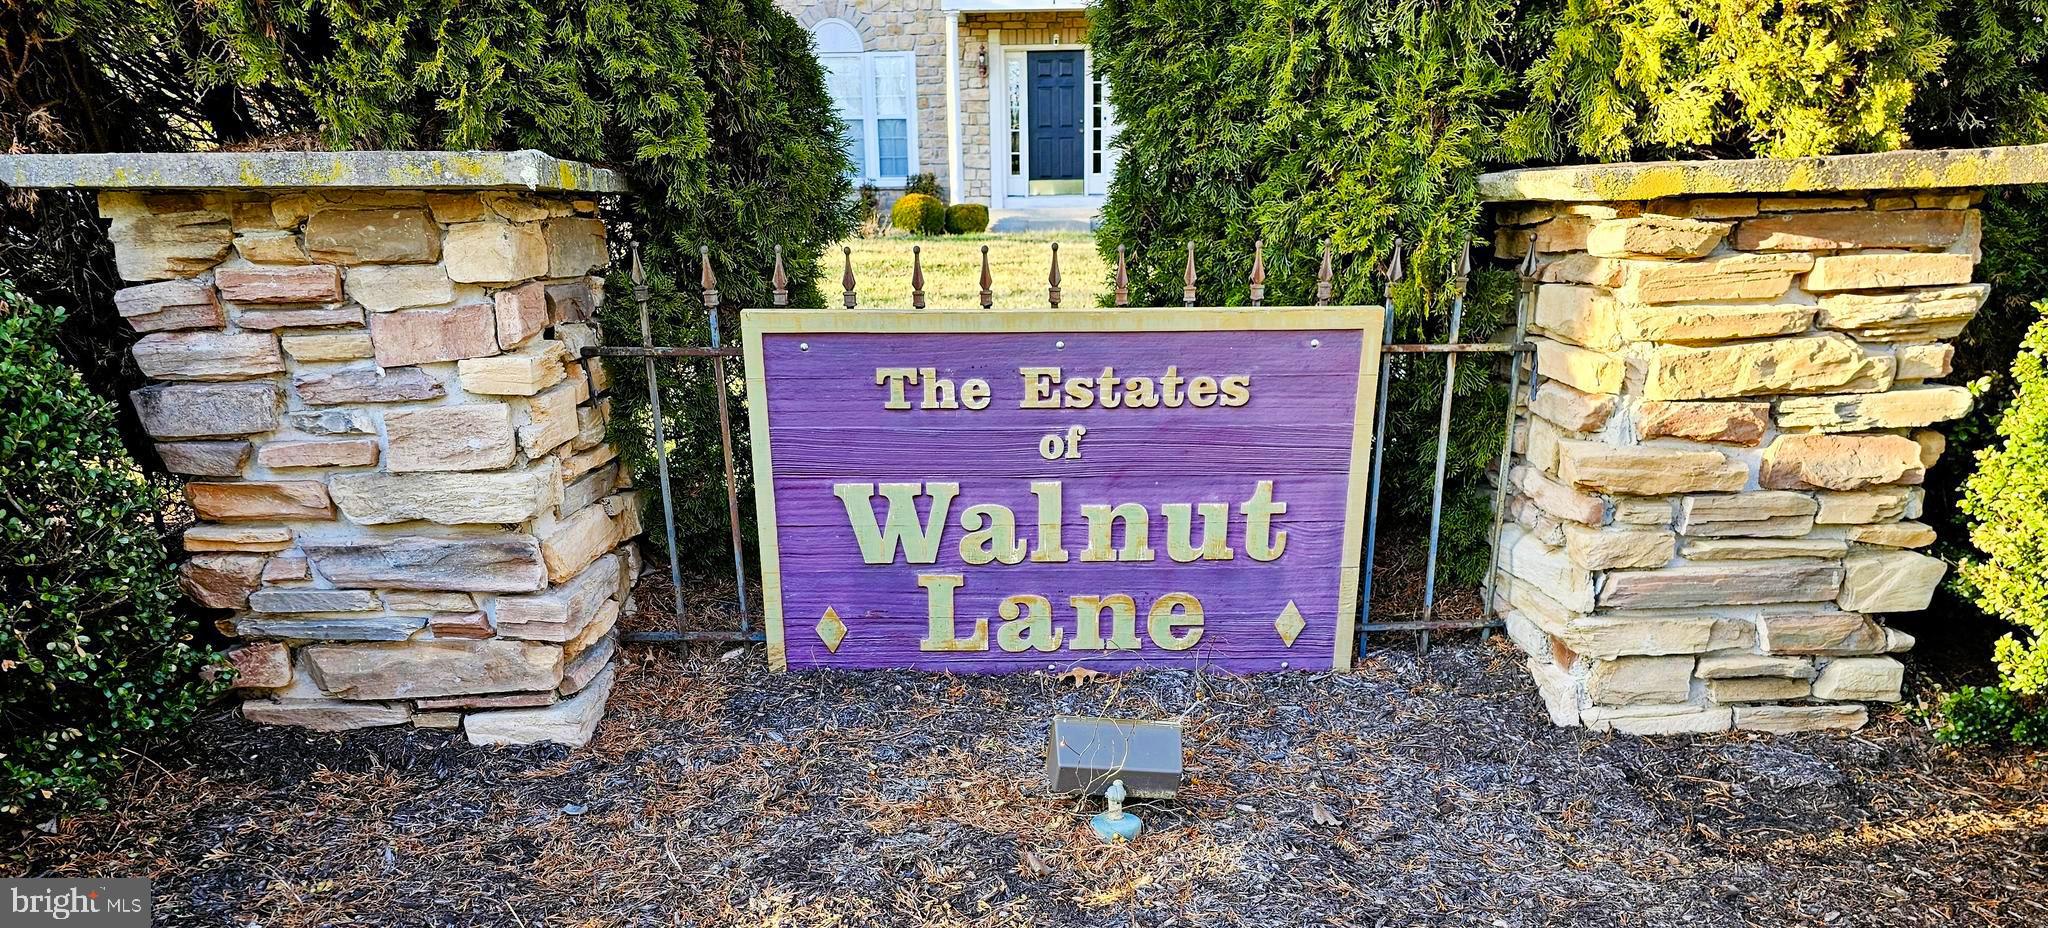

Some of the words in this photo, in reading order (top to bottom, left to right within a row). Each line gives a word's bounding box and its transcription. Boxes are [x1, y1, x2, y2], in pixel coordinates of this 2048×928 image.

[876, 367, 992, 411] The
[1019, 365, 1251, 409] Estates
[1039, 424, 1087, 460] of
[833, 480, 1287, 565] Walnut
[917, 572, 1205, 653] Lane
